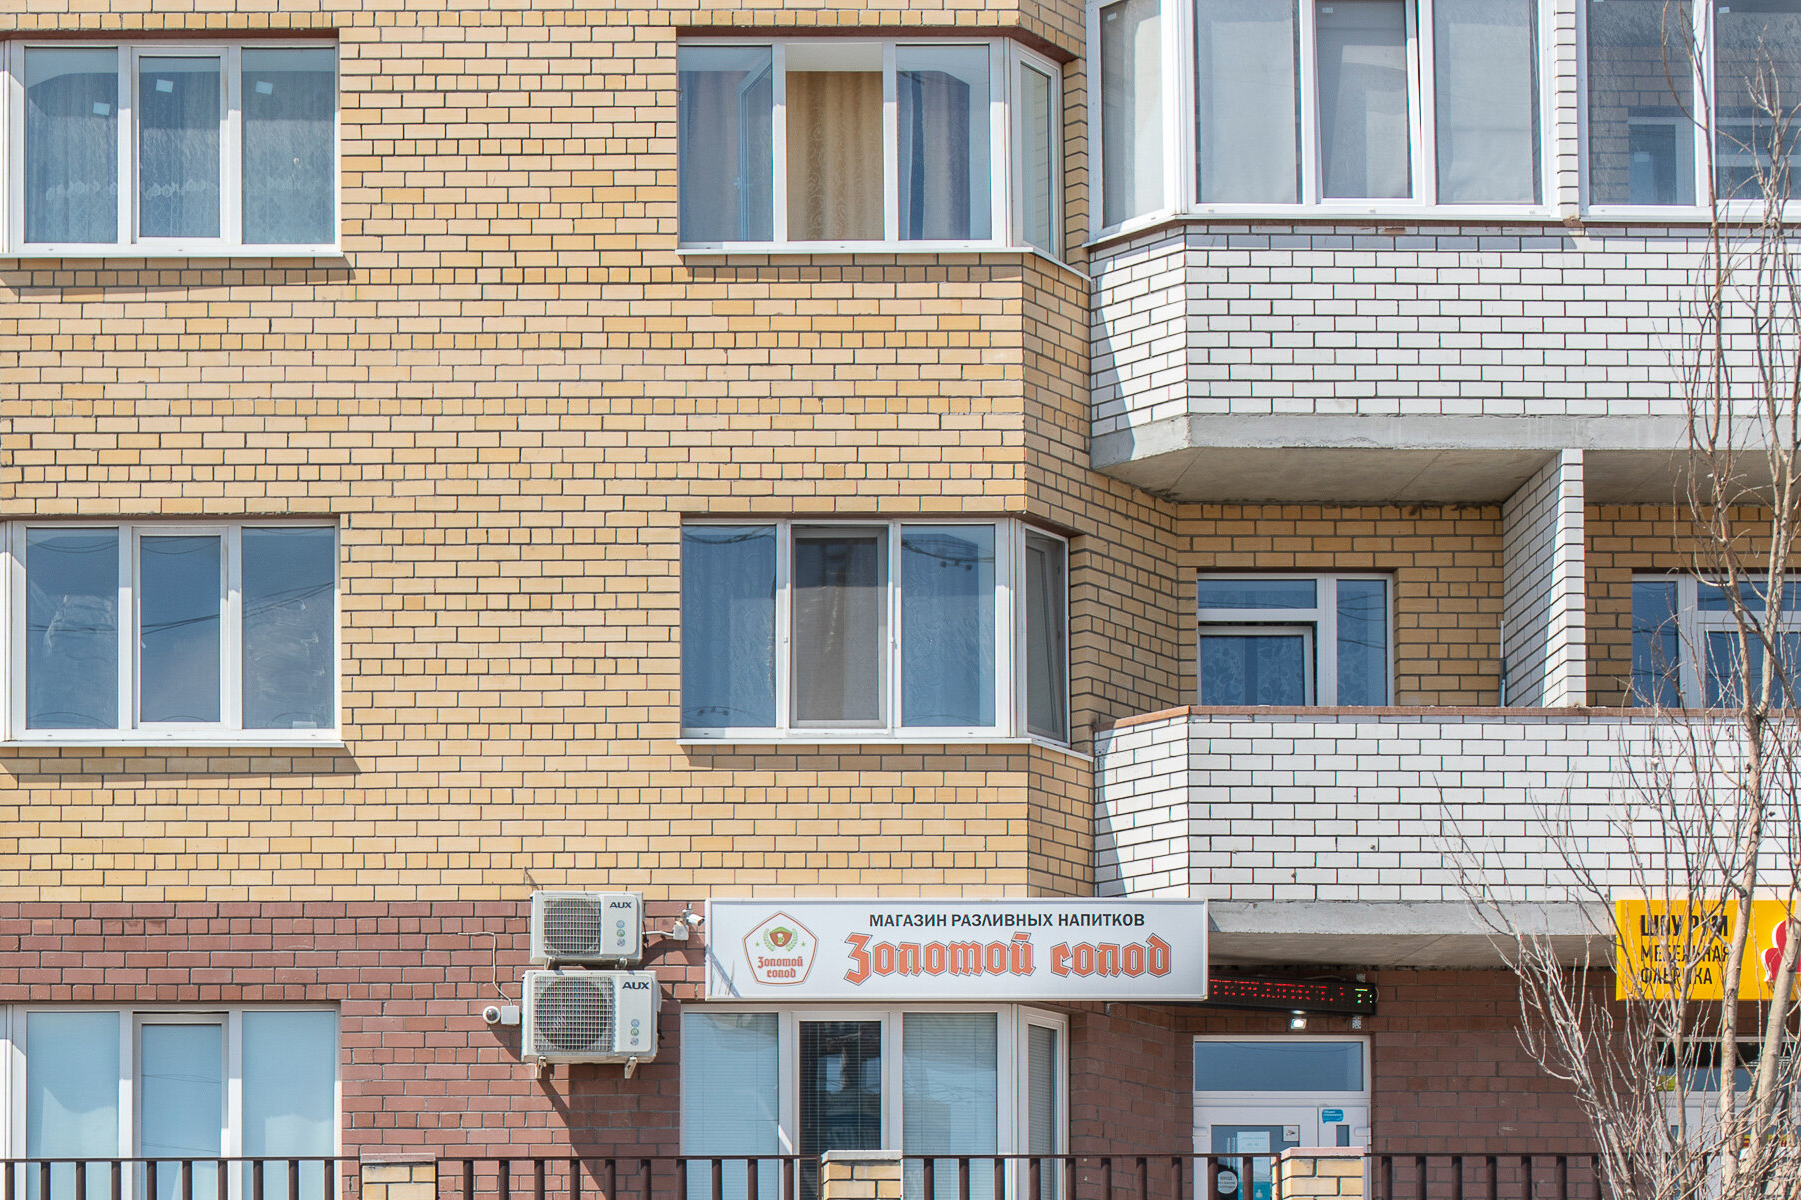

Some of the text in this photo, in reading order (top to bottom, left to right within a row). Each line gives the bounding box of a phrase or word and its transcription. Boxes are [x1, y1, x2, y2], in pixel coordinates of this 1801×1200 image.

[869, 913, 1145, 928] МАГАЗИН РАЗЛИВНЫХ НАПИТКОВ
[622, 981, 650, 990] AUX
